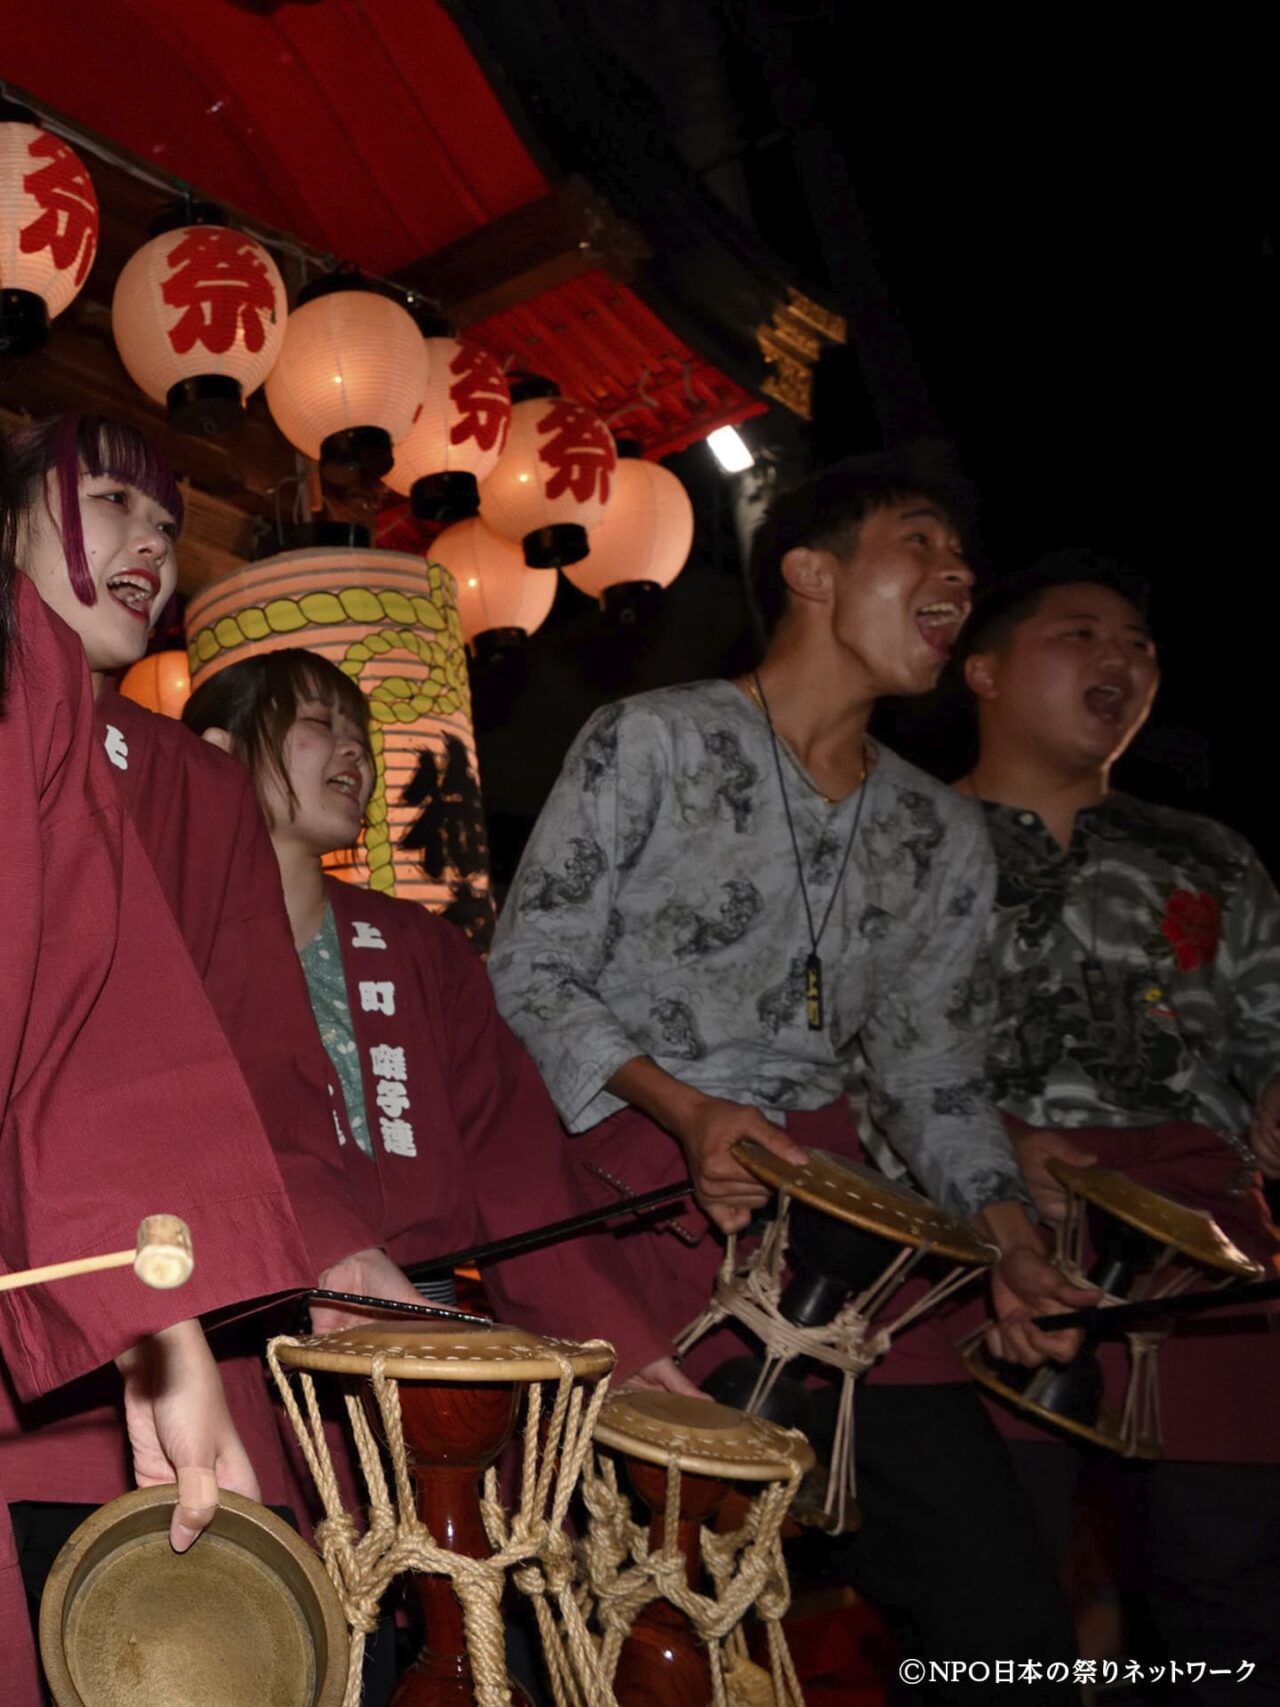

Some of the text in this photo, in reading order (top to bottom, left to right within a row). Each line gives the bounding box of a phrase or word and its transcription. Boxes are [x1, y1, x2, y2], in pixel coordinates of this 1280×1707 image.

[19, 132, 99, 287] 祭
[160, 228, 277, 355] 祭
[449, 336, 513, 456] 祭
[535, 401, 616, 505] 祭
